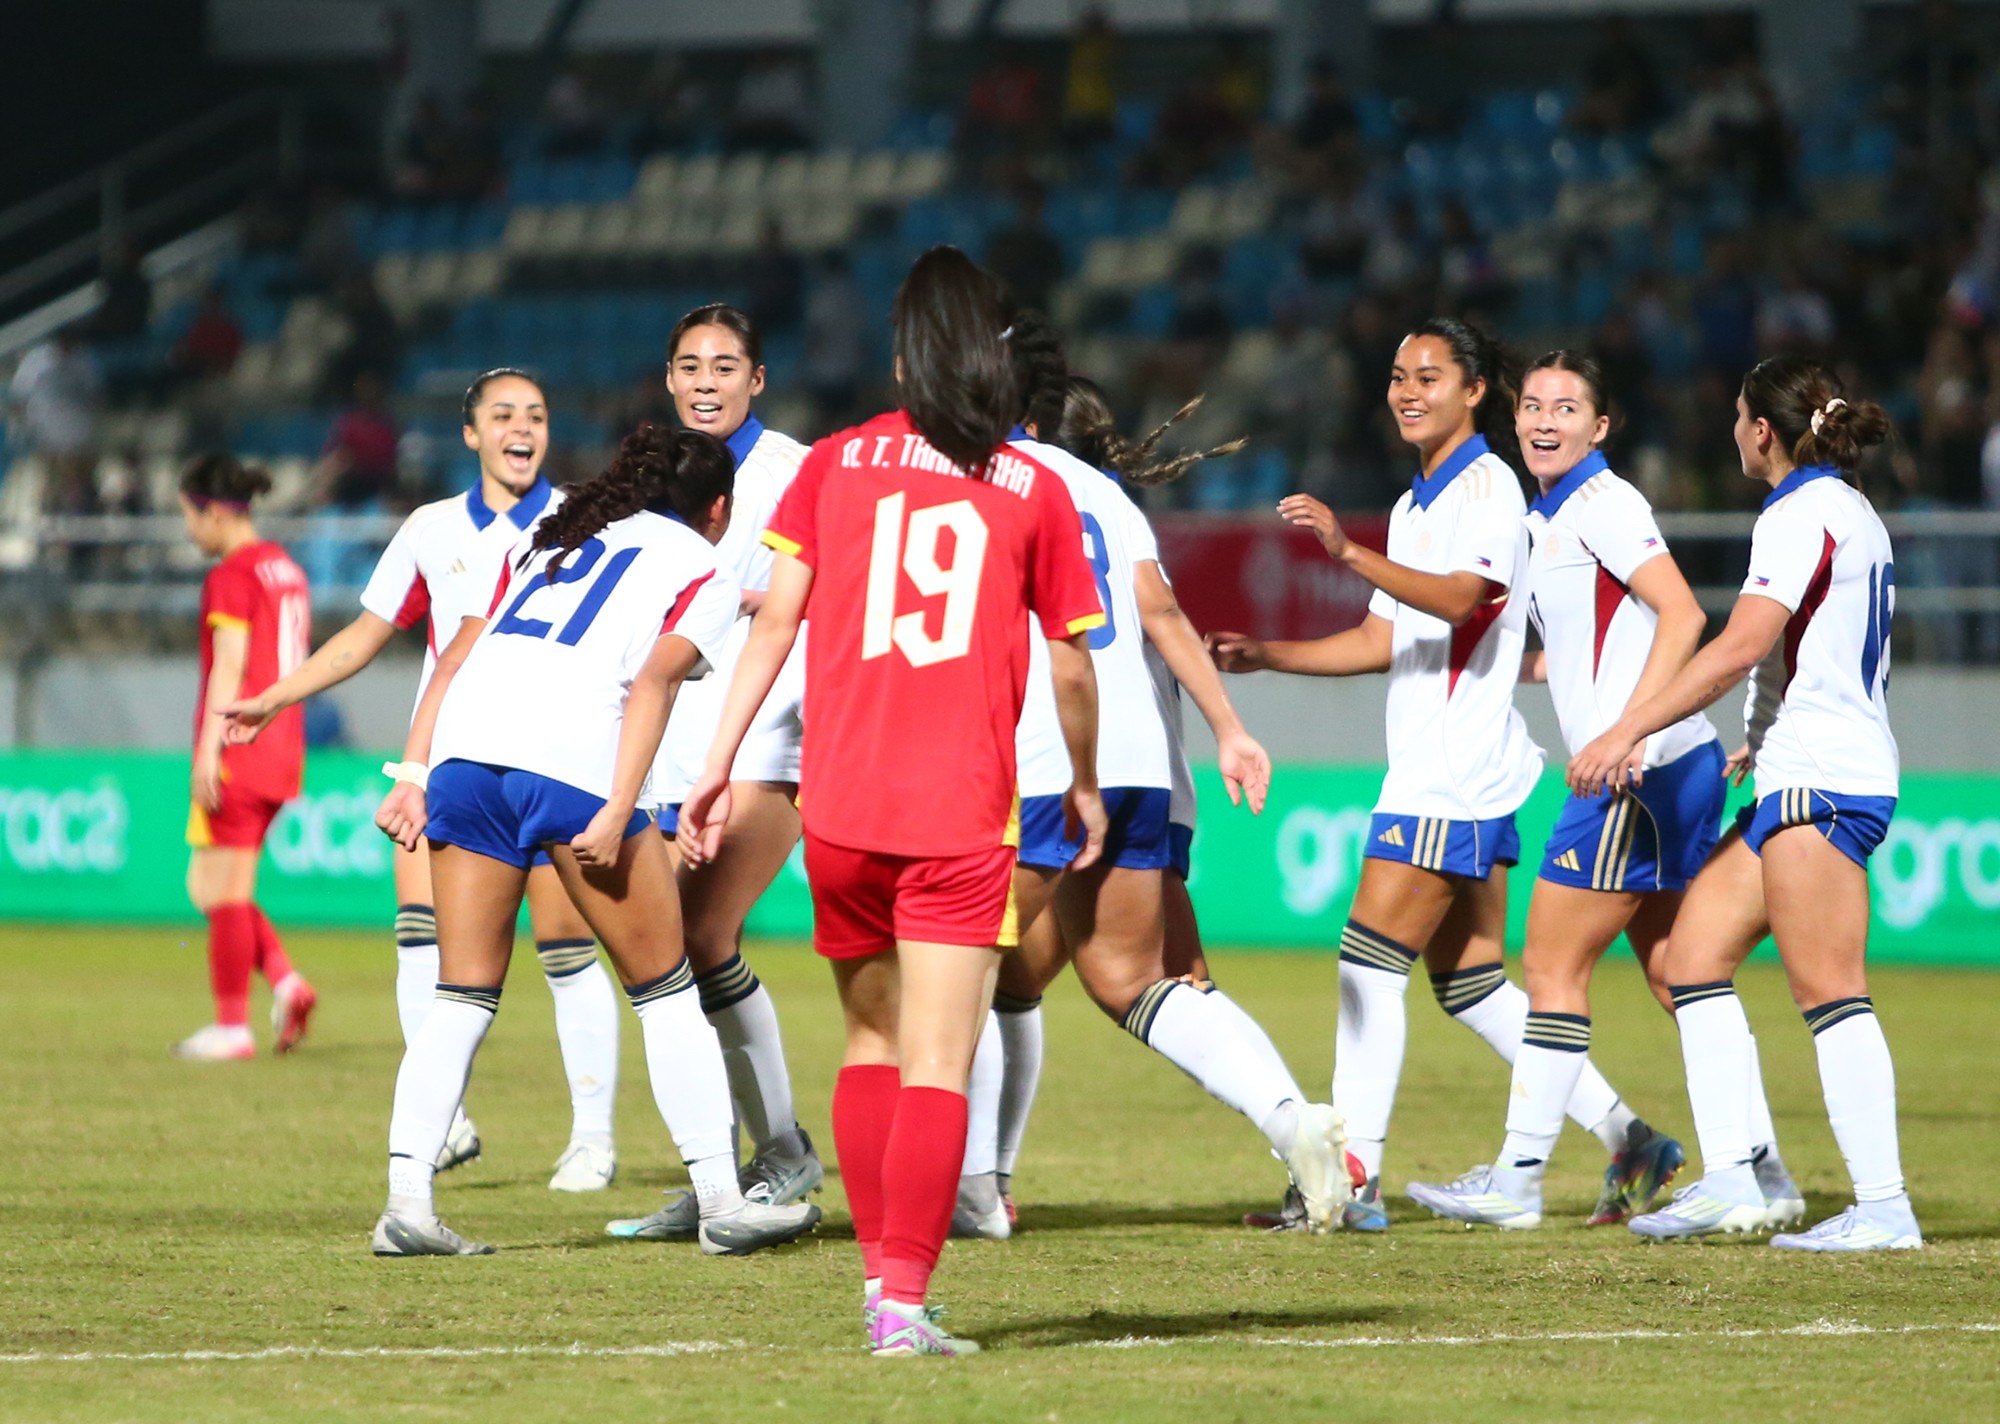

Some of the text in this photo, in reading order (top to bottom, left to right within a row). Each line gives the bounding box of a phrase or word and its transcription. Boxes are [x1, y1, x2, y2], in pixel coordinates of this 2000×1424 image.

[870, 435, 892, 468] T.
[490, 535, 643, 647] 21
[861, 490, 989, 668] 19
